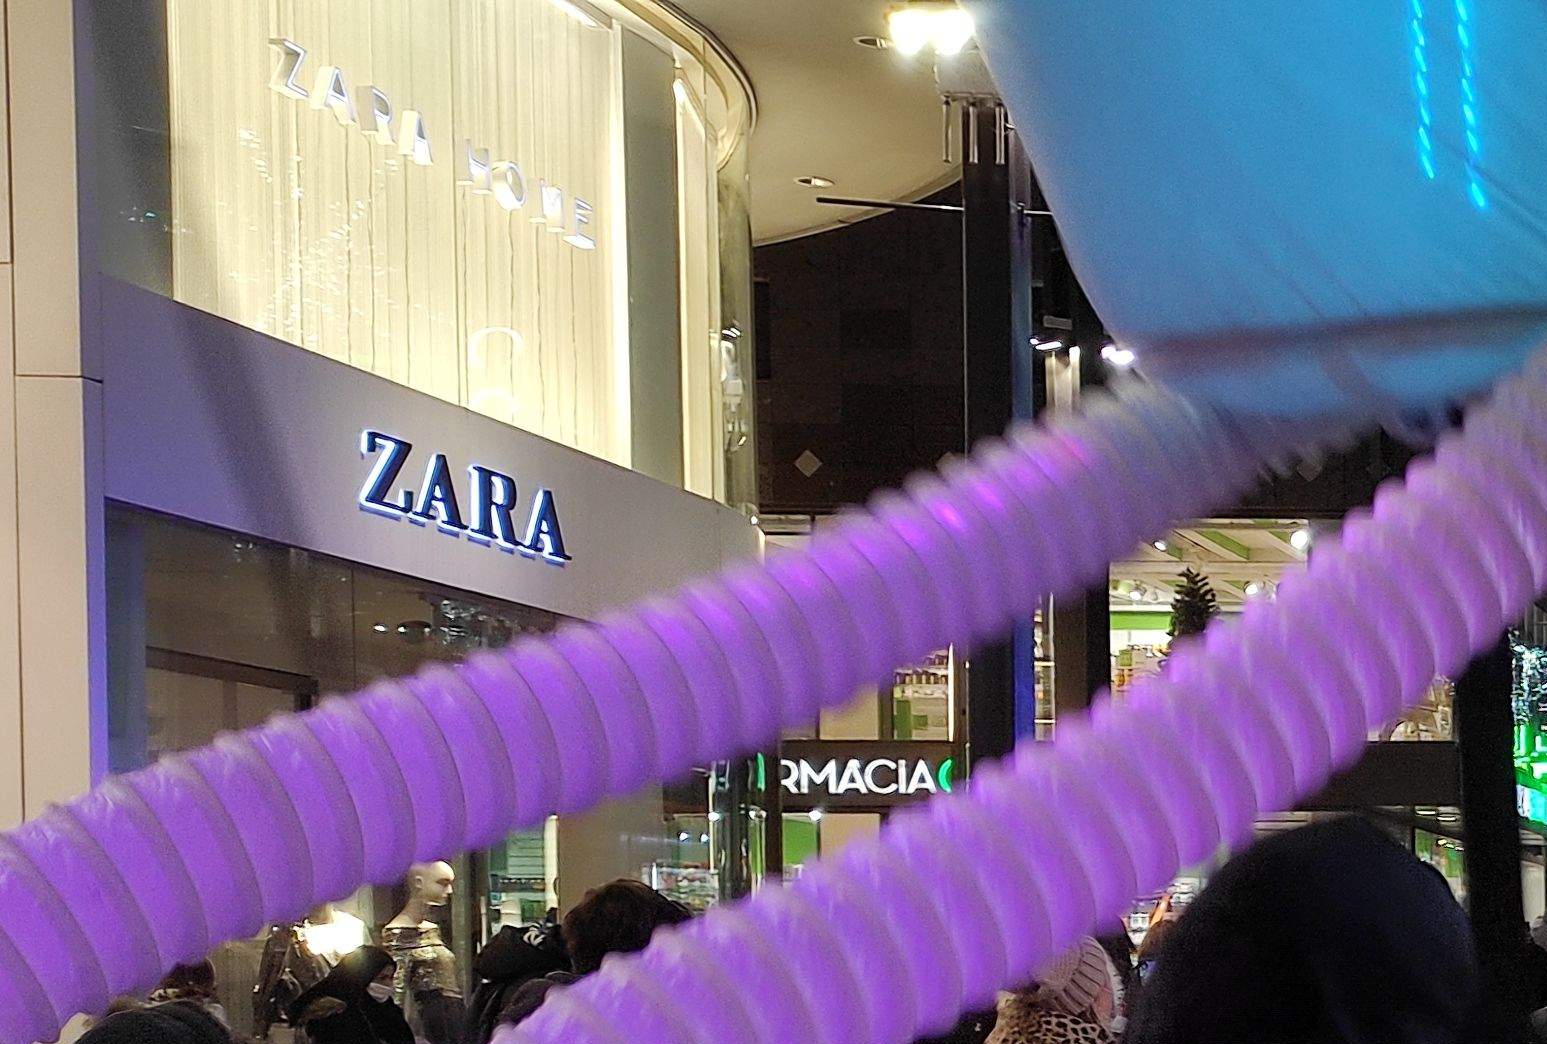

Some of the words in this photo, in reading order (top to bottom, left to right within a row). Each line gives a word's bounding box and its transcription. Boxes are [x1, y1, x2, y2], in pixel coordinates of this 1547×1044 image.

[268, 38, 434, 166] ZARA
[454, 137, 597, 250] HOME
[359, 429, 572, 564] ZARA
